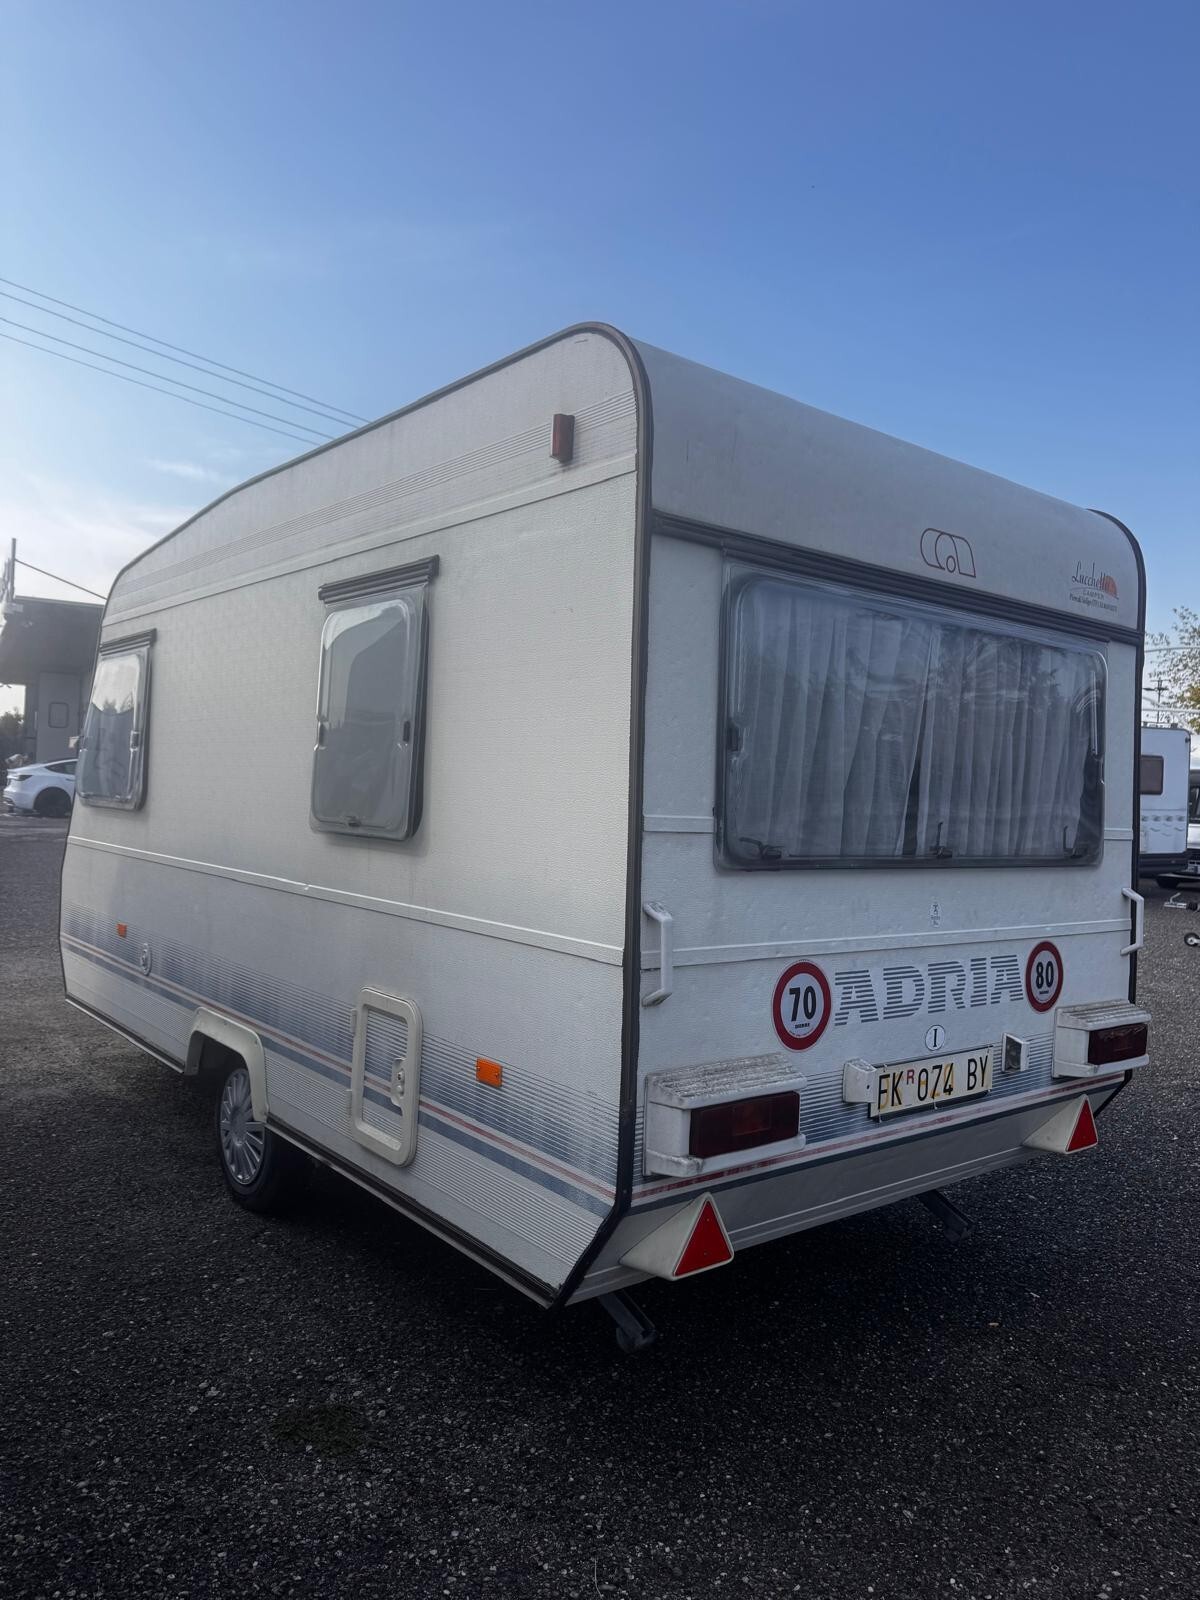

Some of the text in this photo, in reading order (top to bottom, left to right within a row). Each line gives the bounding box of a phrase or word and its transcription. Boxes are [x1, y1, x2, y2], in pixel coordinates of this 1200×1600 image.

[834, 954, 1024, 1027] ADRIA
[1036, 961, 1054, 989] 80
[789, 985, 817, 1022] 70
[967, 1054, 989, 1091] BY
